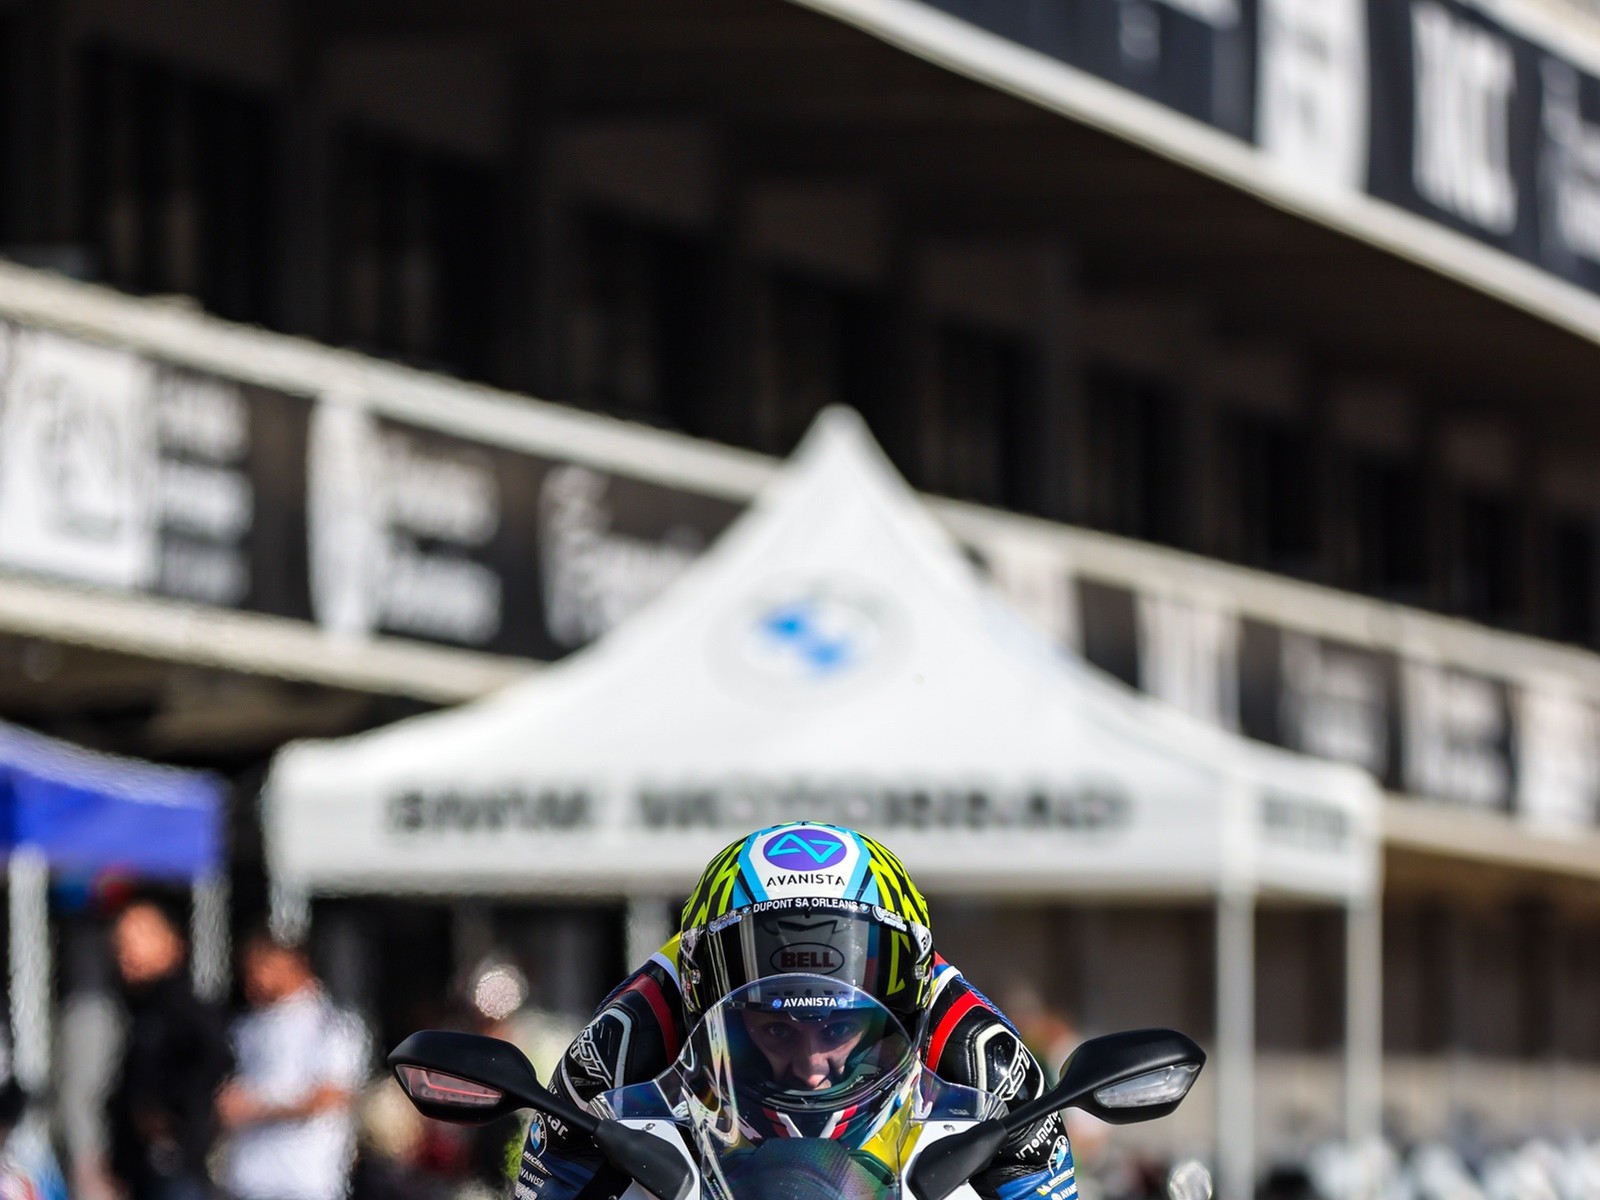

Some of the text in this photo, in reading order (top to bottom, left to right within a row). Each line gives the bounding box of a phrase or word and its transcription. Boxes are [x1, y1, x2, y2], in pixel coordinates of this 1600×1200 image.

[766, 873, 845, 887] AVANISTA
[752, 897, 858, 913] DUPONT SA ORLEANS
[780, 951, 836, 969] BELL
[783, 997, 837, 1008] AVANISTA
